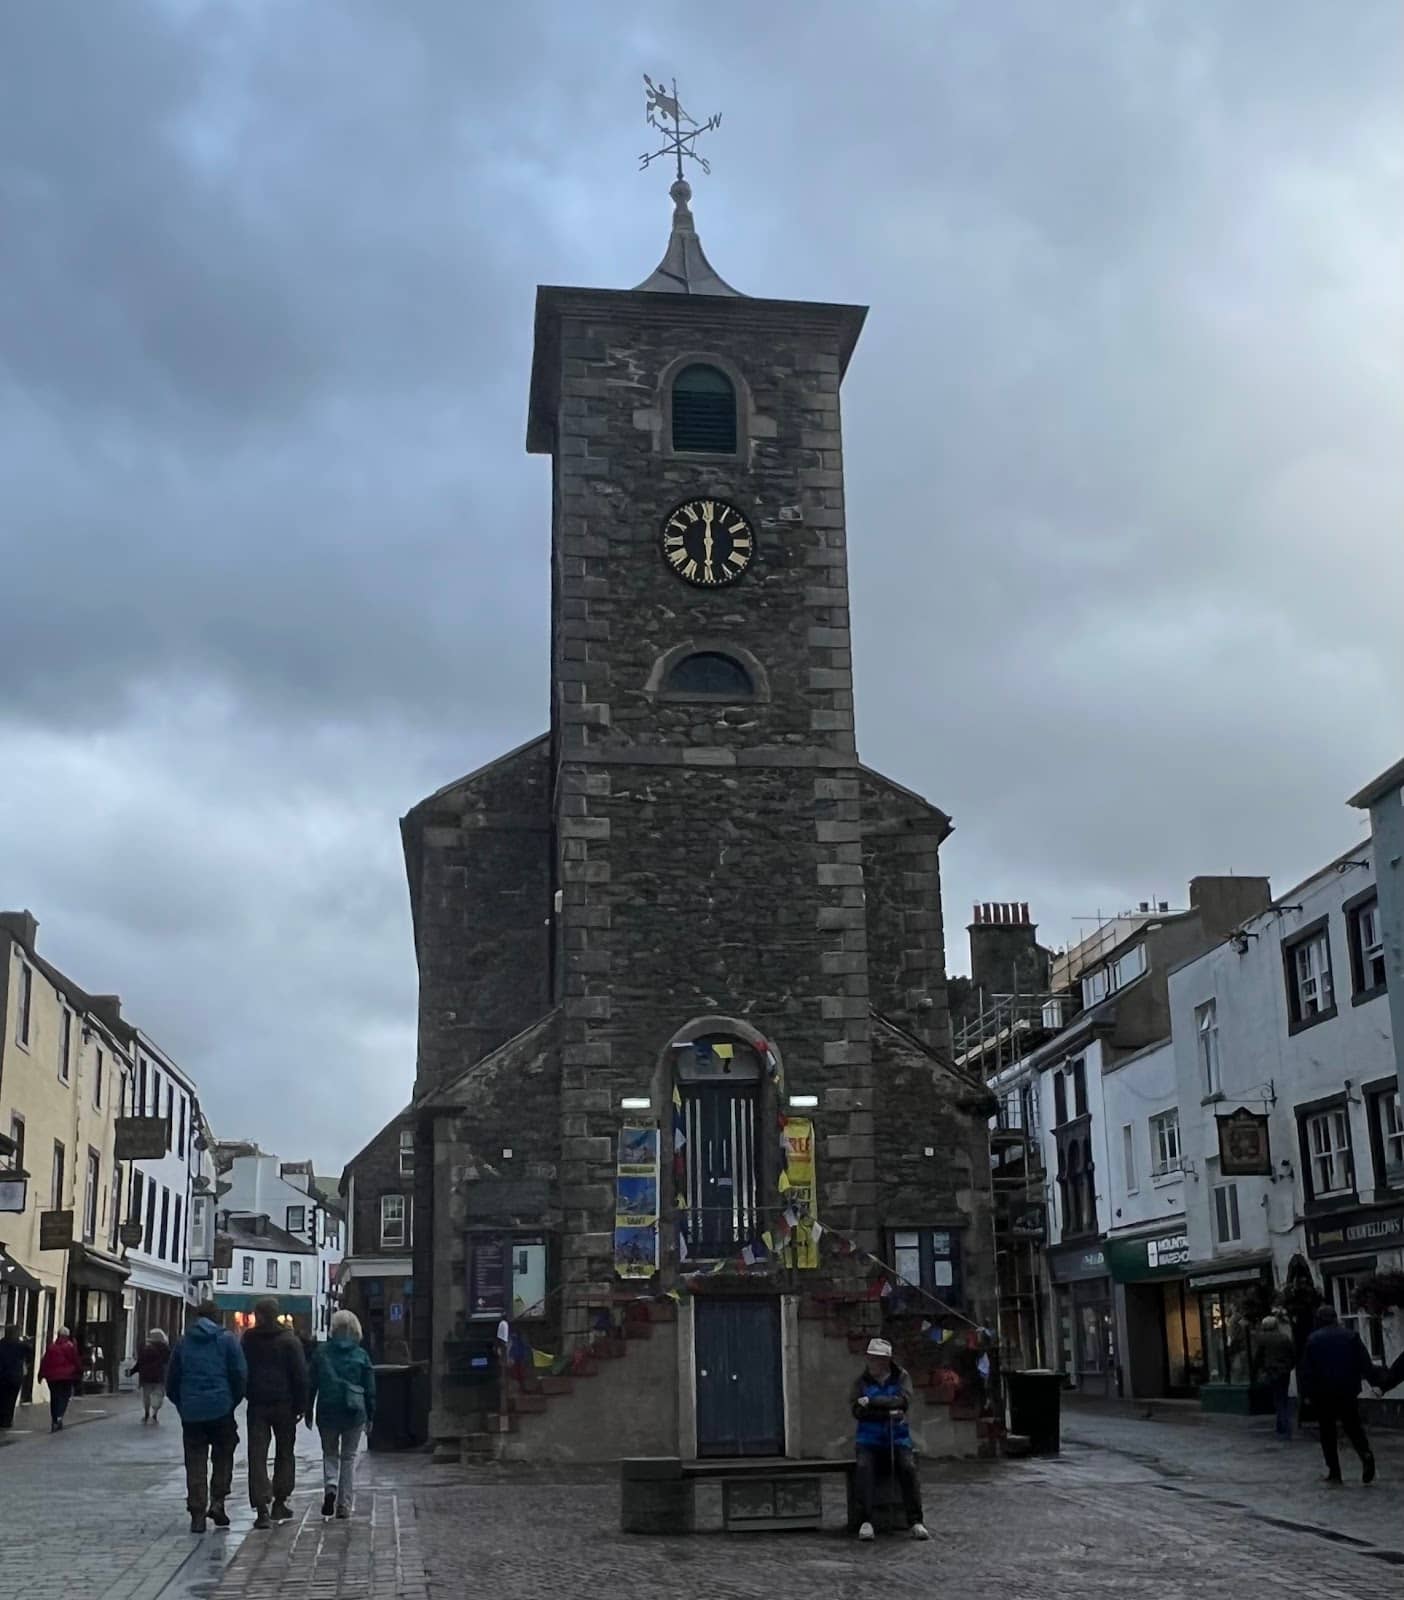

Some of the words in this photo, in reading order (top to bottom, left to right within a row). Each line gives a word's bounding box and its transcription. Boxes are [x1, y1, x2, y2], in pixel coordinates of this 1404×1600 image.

[708, 112, 722, 131] W
[719, 506, 730, 524] I
[728, 521, 746, 534] II
